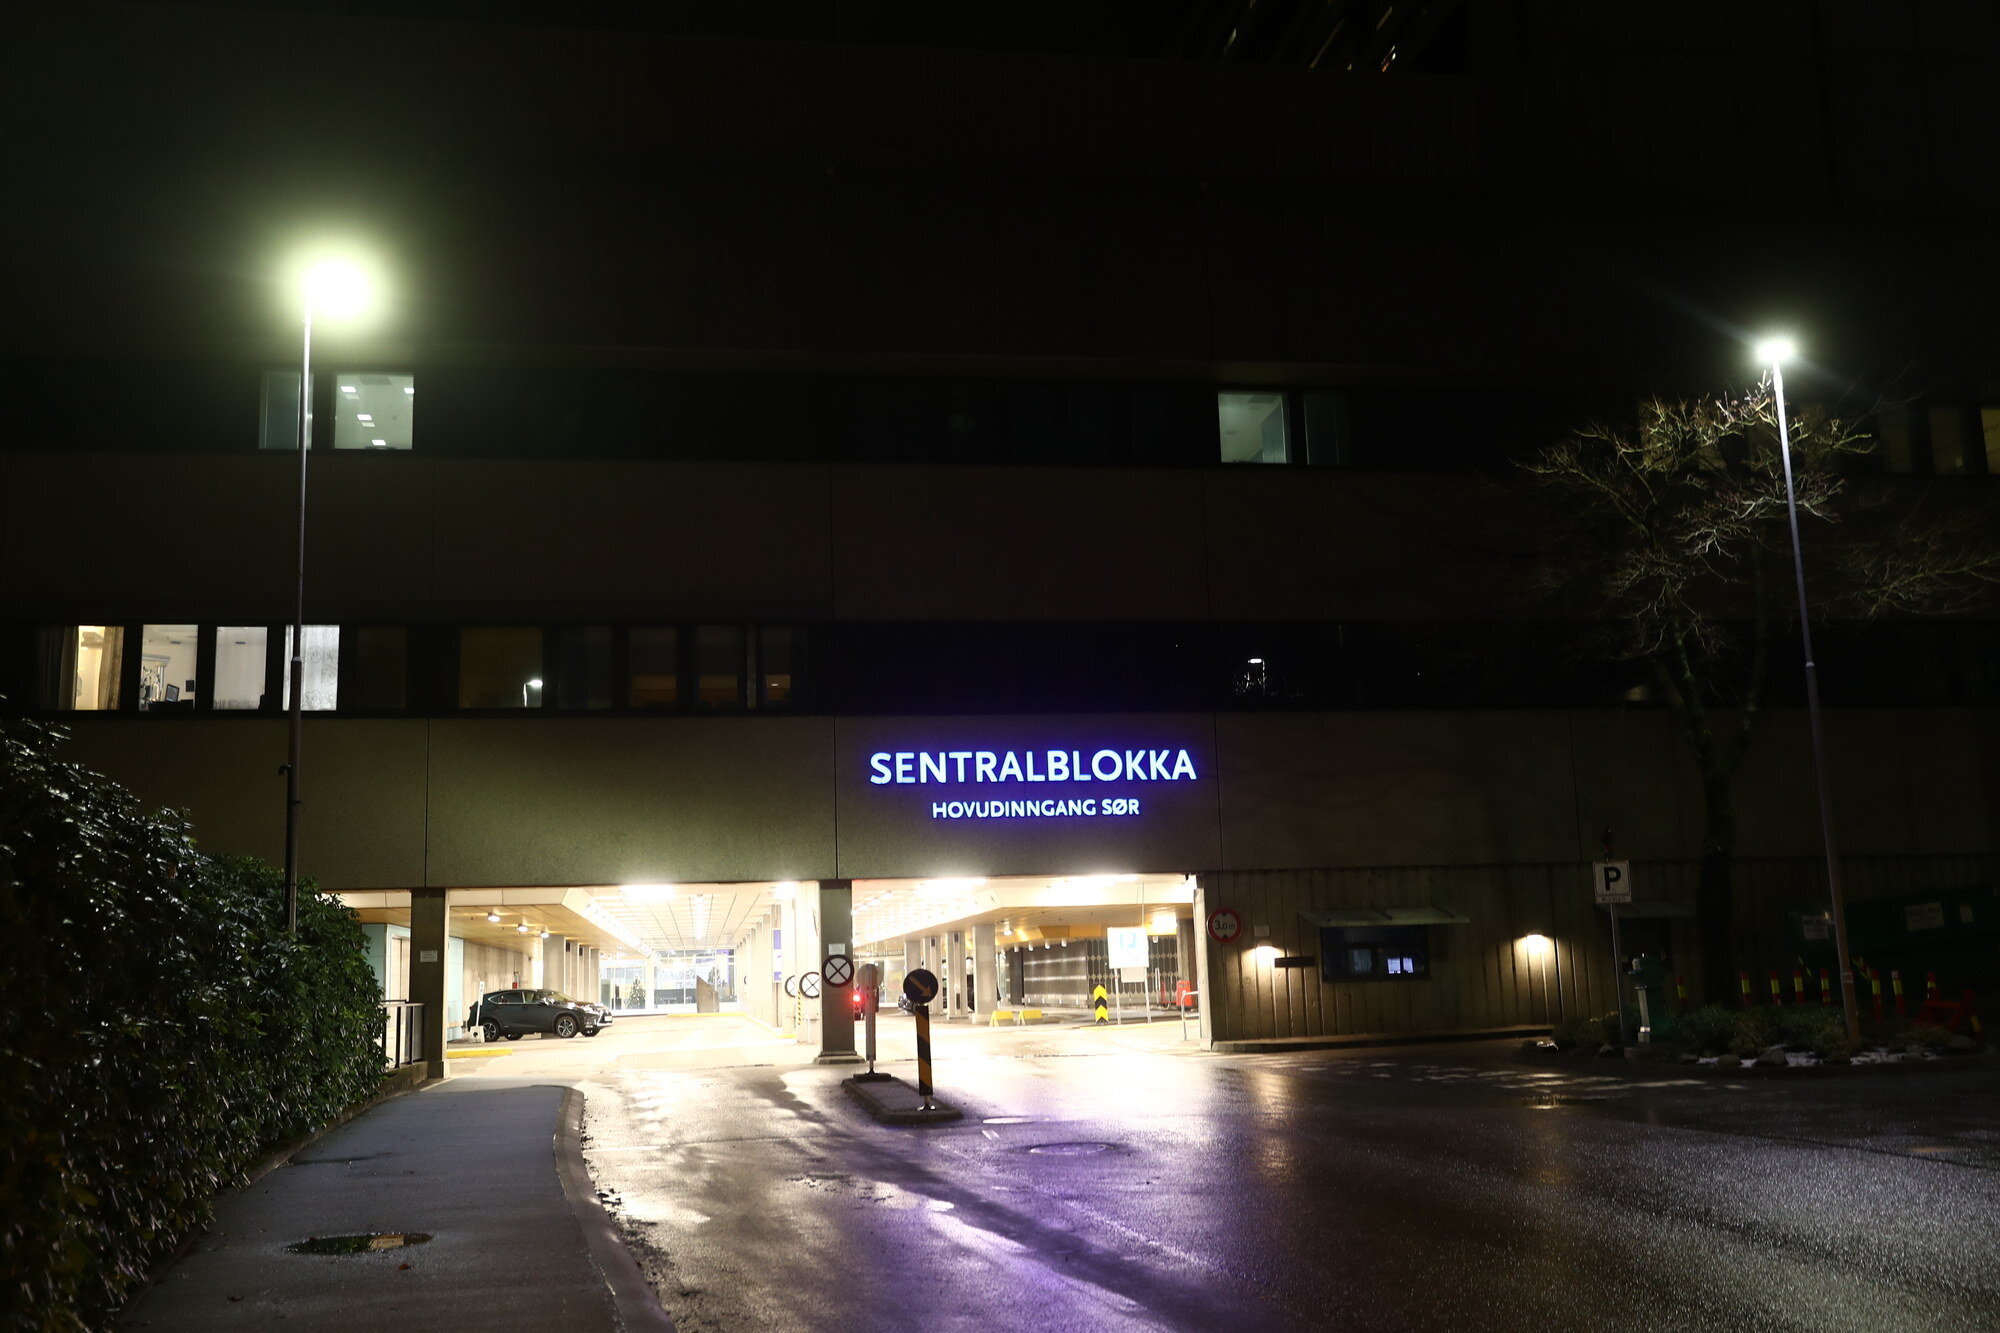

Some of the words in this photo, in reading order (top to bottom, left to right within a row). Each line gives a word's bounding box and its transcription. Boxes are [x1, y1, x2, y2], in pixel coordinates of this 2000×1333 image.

[869, 750, 1197, 784] SENTRALBLOKKA
[932, 800, 1096, 818] HOVUDINNGANG
[1101, 799, 1140, 816] SØR
[1604, 867, 1621, 891] P
